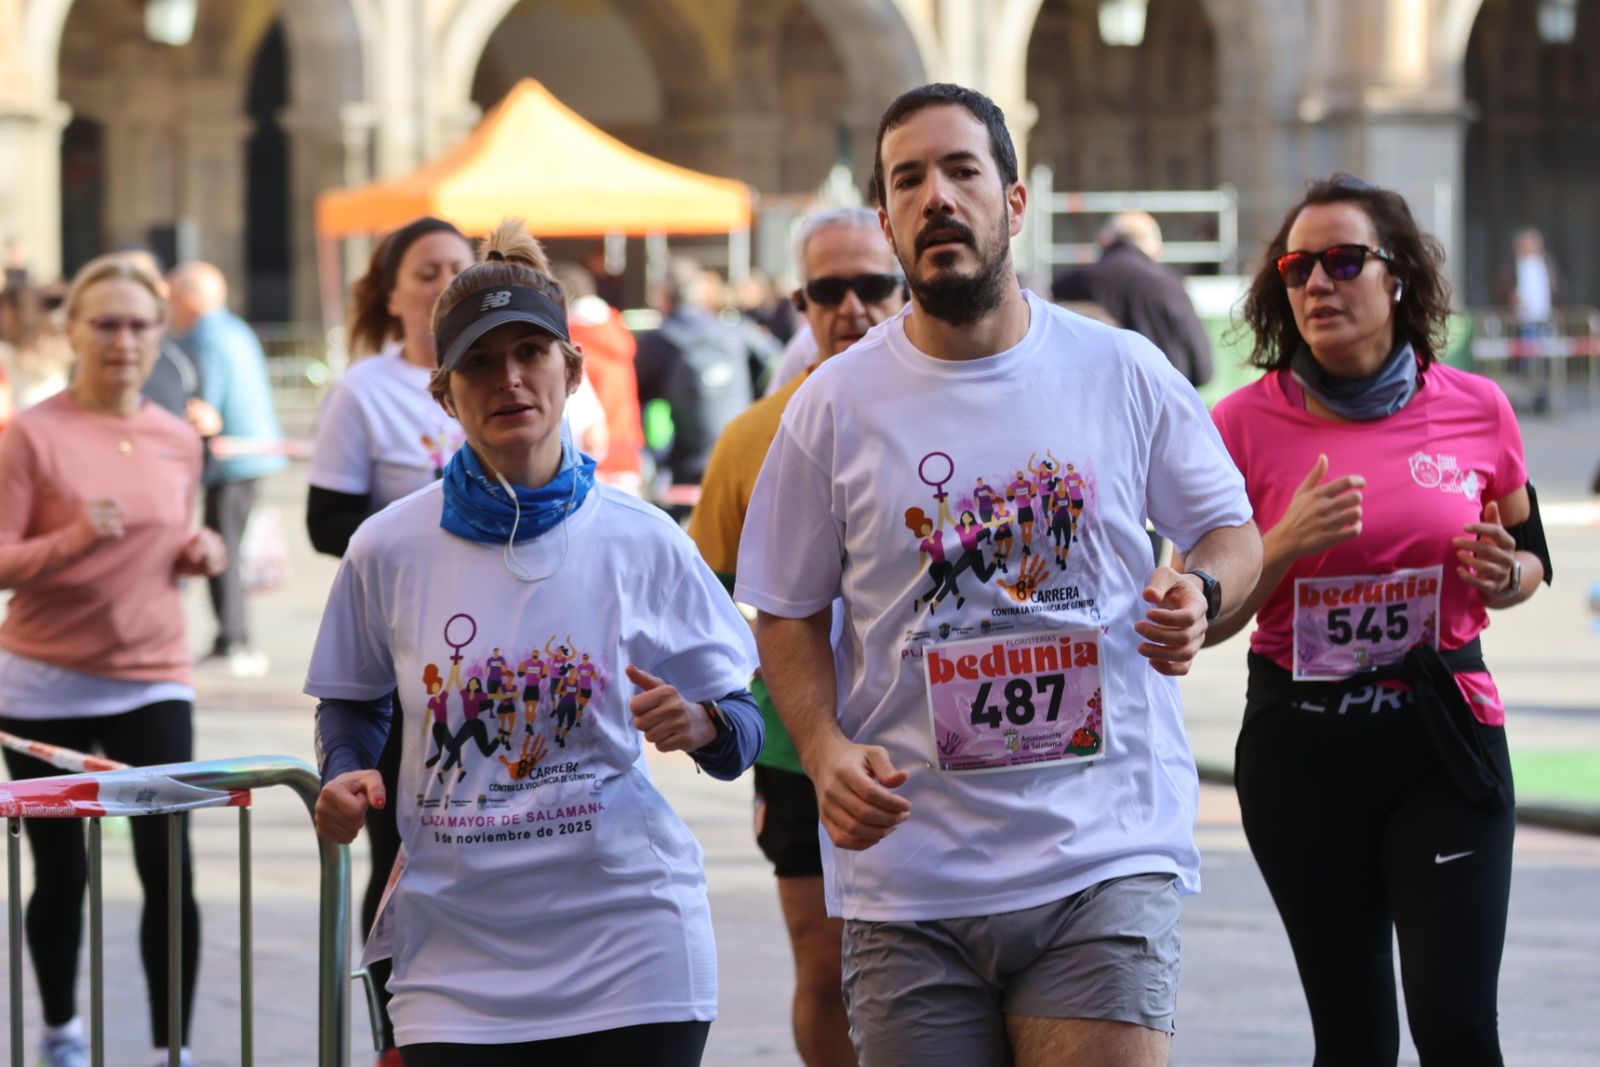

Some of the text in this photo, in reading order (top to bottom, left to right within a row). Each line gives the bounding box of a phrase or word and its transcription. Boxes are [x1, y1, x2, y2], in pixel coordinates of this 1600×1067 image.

[1030, 586, 1079, 604] CARRERA
[1299, 576, 1438, 608] bedunia
[991, 606, 1020, 617] CONTRA
[1020, 606, 1030, 614] LA
[1061, 602, 1070, 611] DE
[1327, 603, 1409, 645] 545
[927, 636, 1099, 686] bedunia
[970, 672, 1066, 729] 487
[515, 783, 525, 792] LA
[560, 775, 569, 783] DE
[442, 833, 452, 844] de
[456, 829, 531, 845] noviembre
[537, 826, 553, 838] de
[559, 820, 592, 835] 2025
[448, 816, 495, 828] MAYOR
[502, 814, 520, 826] DE
